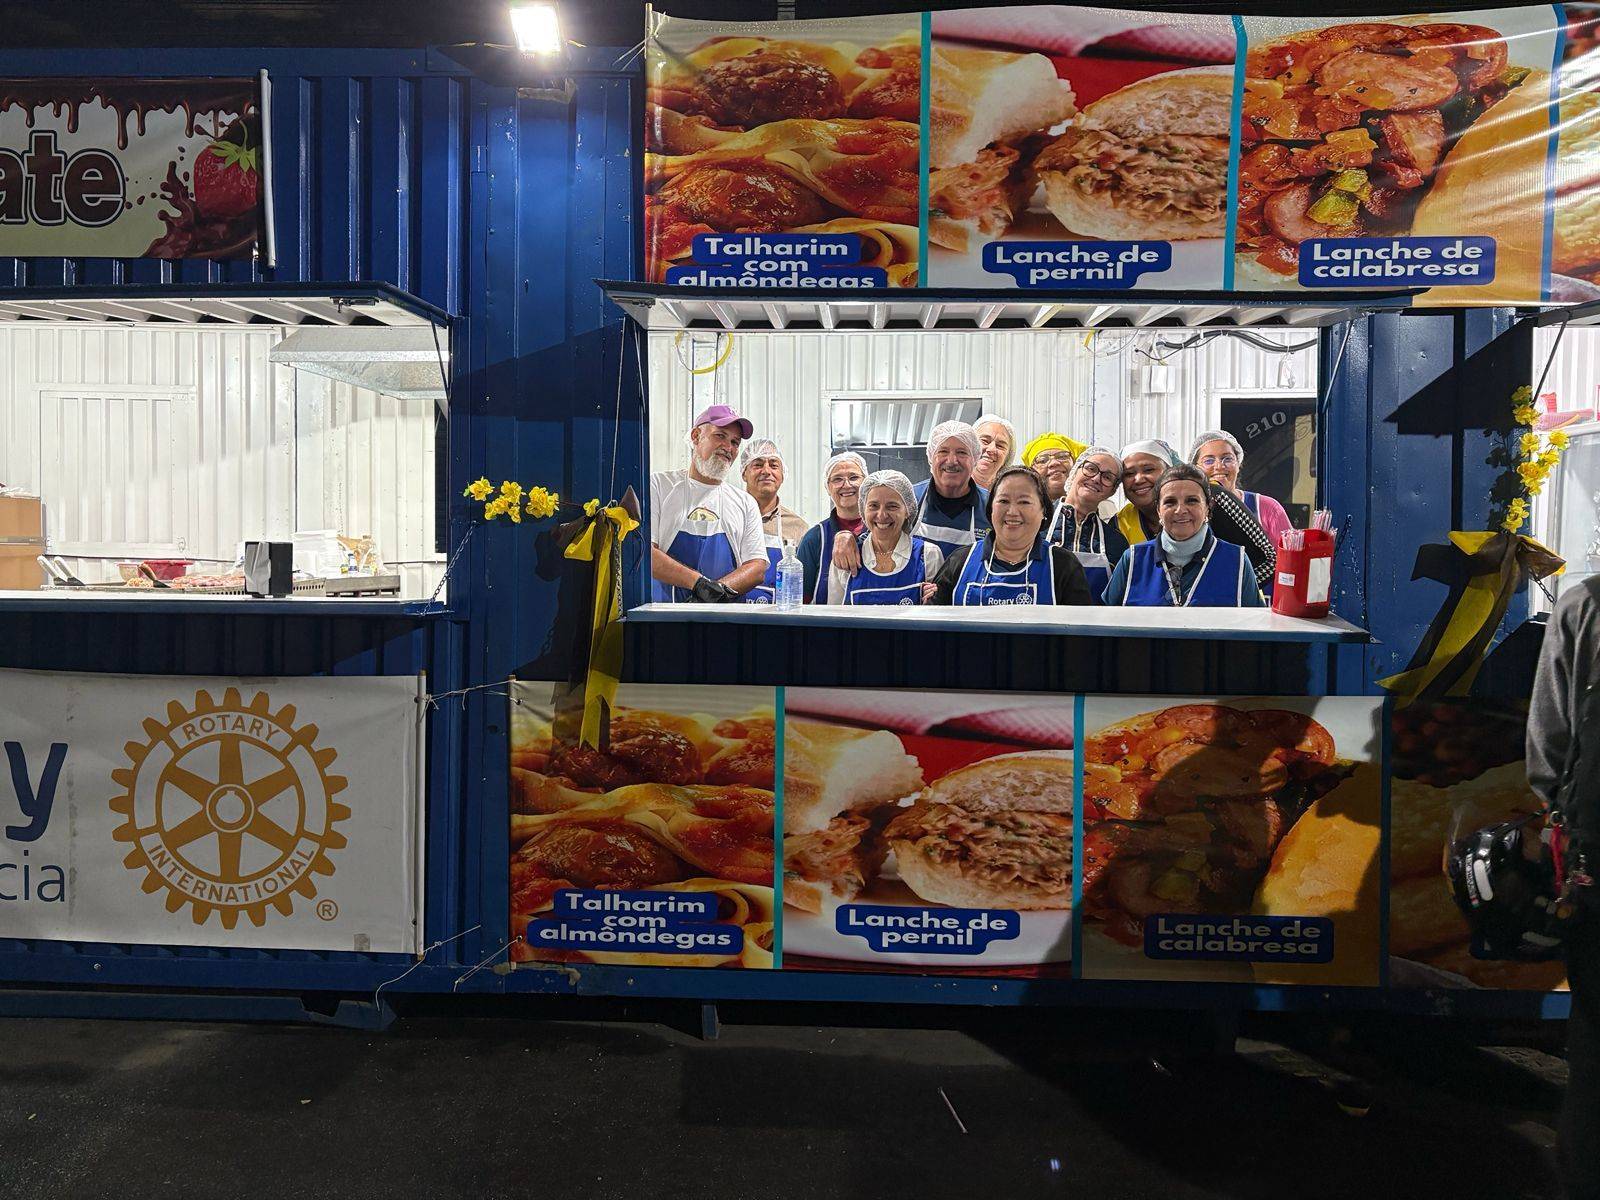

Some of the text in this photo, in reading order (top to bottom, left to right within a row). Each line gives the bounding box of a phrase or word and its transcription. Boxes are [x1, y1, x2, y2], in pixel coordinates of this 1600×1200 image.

[704, 237, 848, 256] Talharim
[996, 244, 1159, 264] Lanche de
[1313, 240, 1483, 261] Lanche de
[743, 259, 809, 272] com
[1029, 261, 1123, 284] pernil
[1313, 259, 1480, 278] calabresa
[1245, 411, 1287, 439] 210
[987, 597, 1015, 605] Rotary
[182, 714, 280, 742] ROTARY
[4, 741, 68, 842] y
[0, 849, 65, 902] cia
[148, 844, 315, 903] INTERNATIONAL
[565, 892, 705, 913] Talharim
[603, 915, 666, 928] com
[849, 908, 1008, 931] Lanche de
[1157, 918, 1321, 938] Lanche de
[539, 923, 731, 948] almôndegas
[882, 928, 973, 948] pernil
[1158, 935, 1318, 955] calabresa
